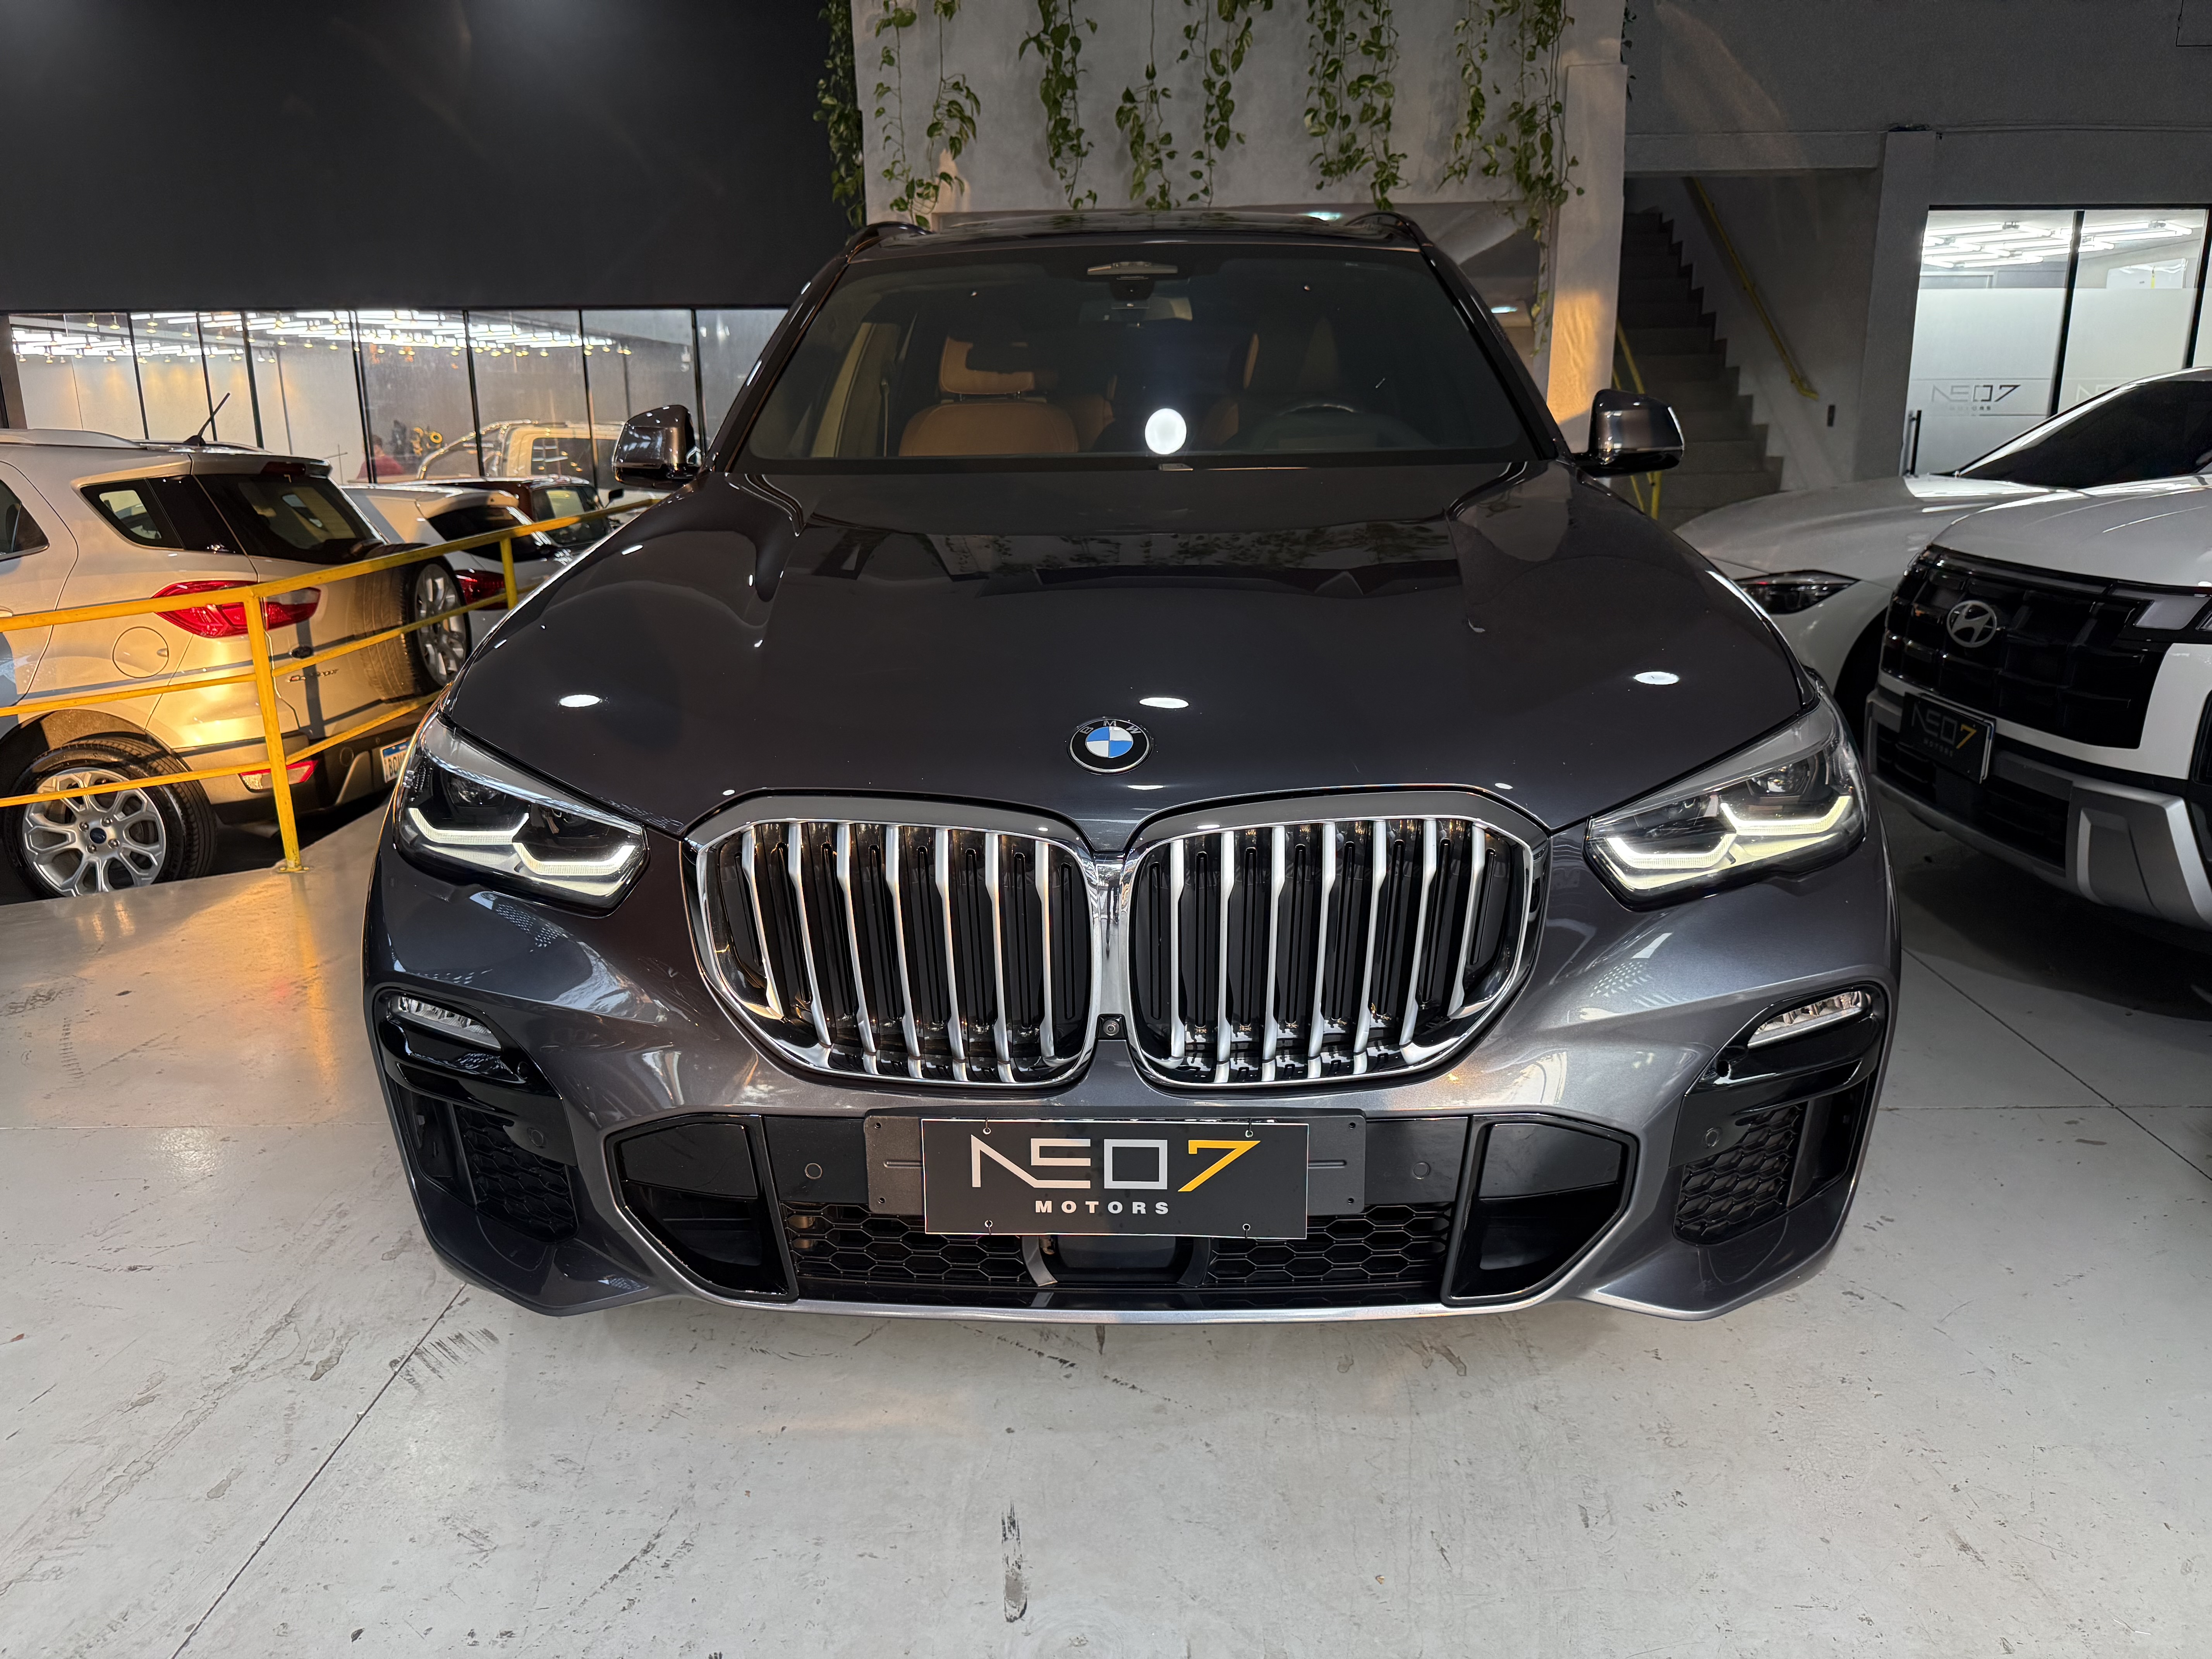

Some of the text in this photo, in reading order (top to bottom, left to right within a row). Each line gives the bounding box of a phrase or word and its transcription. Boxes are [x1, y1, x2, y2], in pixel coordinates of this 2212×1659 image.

[1931, 383, 2021, 402] NEO7
[1079, 720, 1142, 734] BMW
[1911, 702, 1977, 749] NEO7
[970, 1134, 1261, 1192] NEO7
[1035, 1200, 1169, 1215] MOTORS
